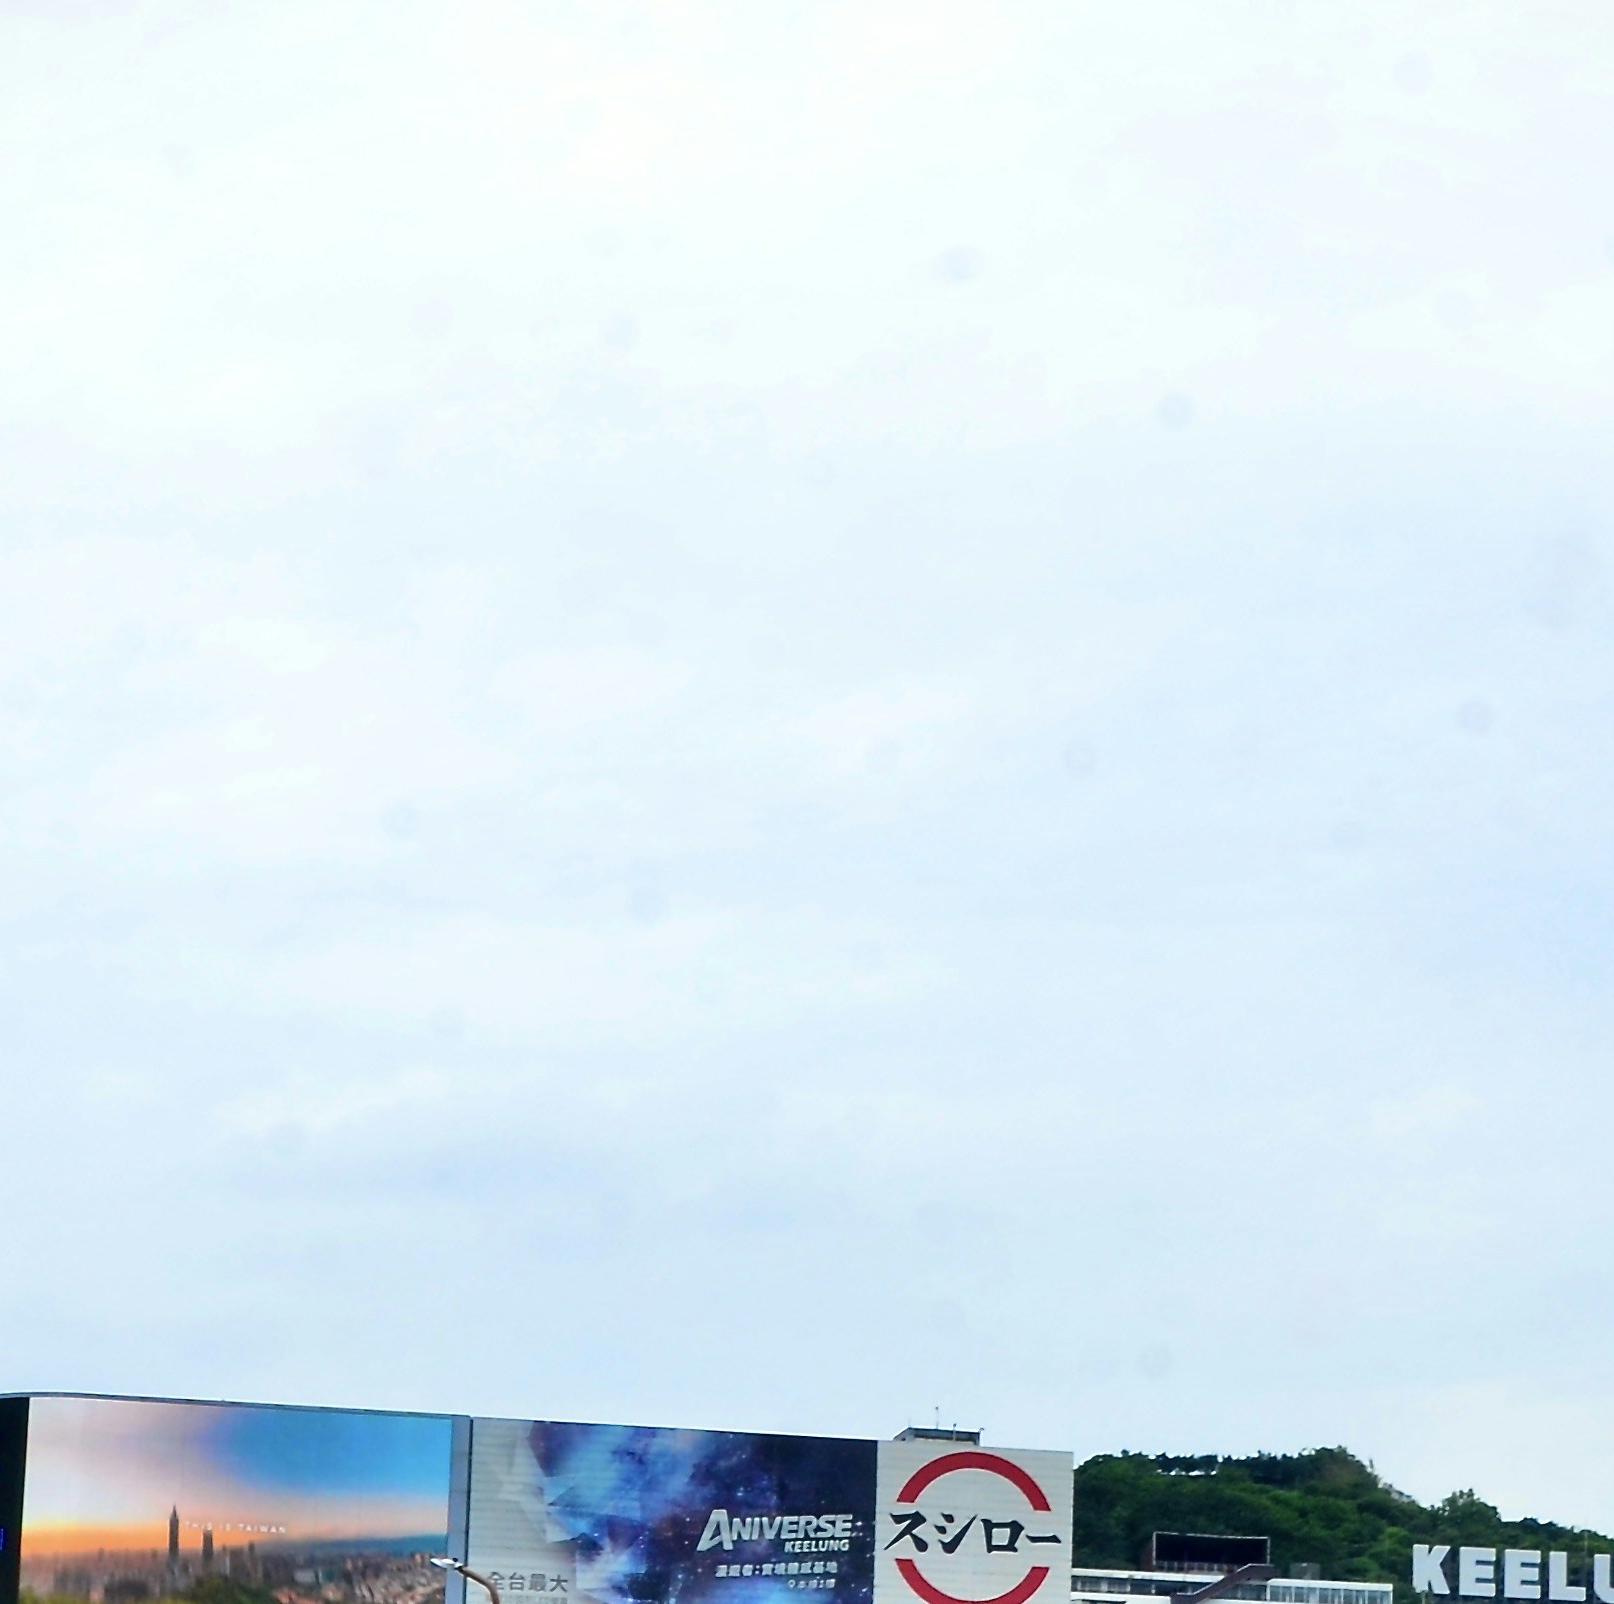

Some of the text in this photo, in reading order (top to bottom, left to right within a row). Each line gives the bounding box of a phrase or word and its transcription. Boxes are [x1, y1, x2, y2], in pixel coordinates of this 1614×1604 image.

[238, 1523, 286, 1534] TAIWAN
[696, 1509, 853, 1552] ANIVERSE
[883, 1510, 1062, 1554] スシロー
[784, 1539, 850, 1553] KEELUNG
[488, 1571, 569, 1593] 全台最大
